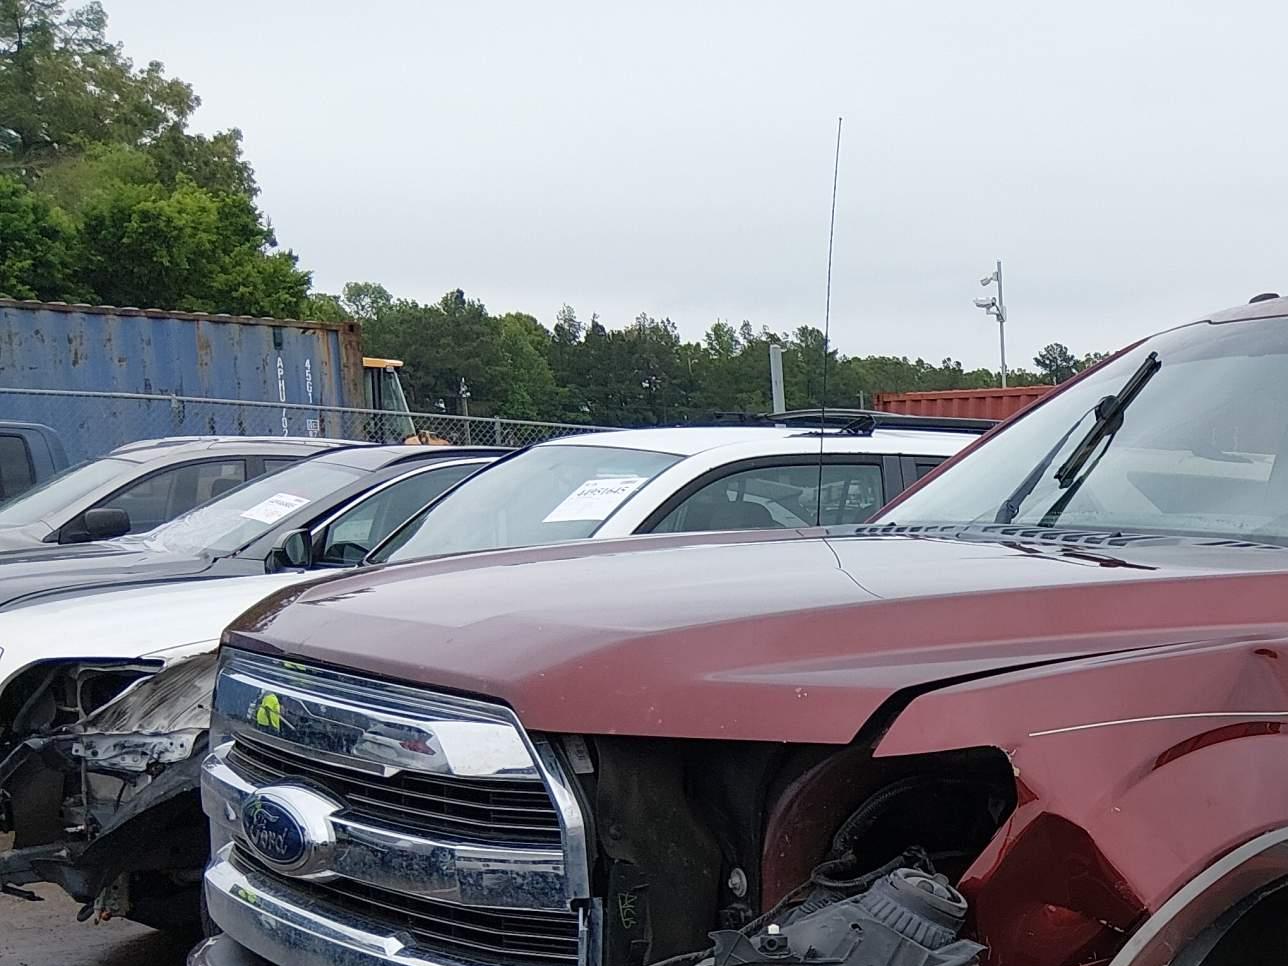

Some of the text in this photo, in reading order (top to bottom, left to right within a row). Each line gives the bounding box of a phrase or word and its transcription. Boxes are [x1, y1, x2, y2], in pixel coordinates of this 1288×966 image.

[276, 356, 286, 402] APHU
[304, 359, 313, 404] 45G1
[250, 808, 289, 856] Ford
